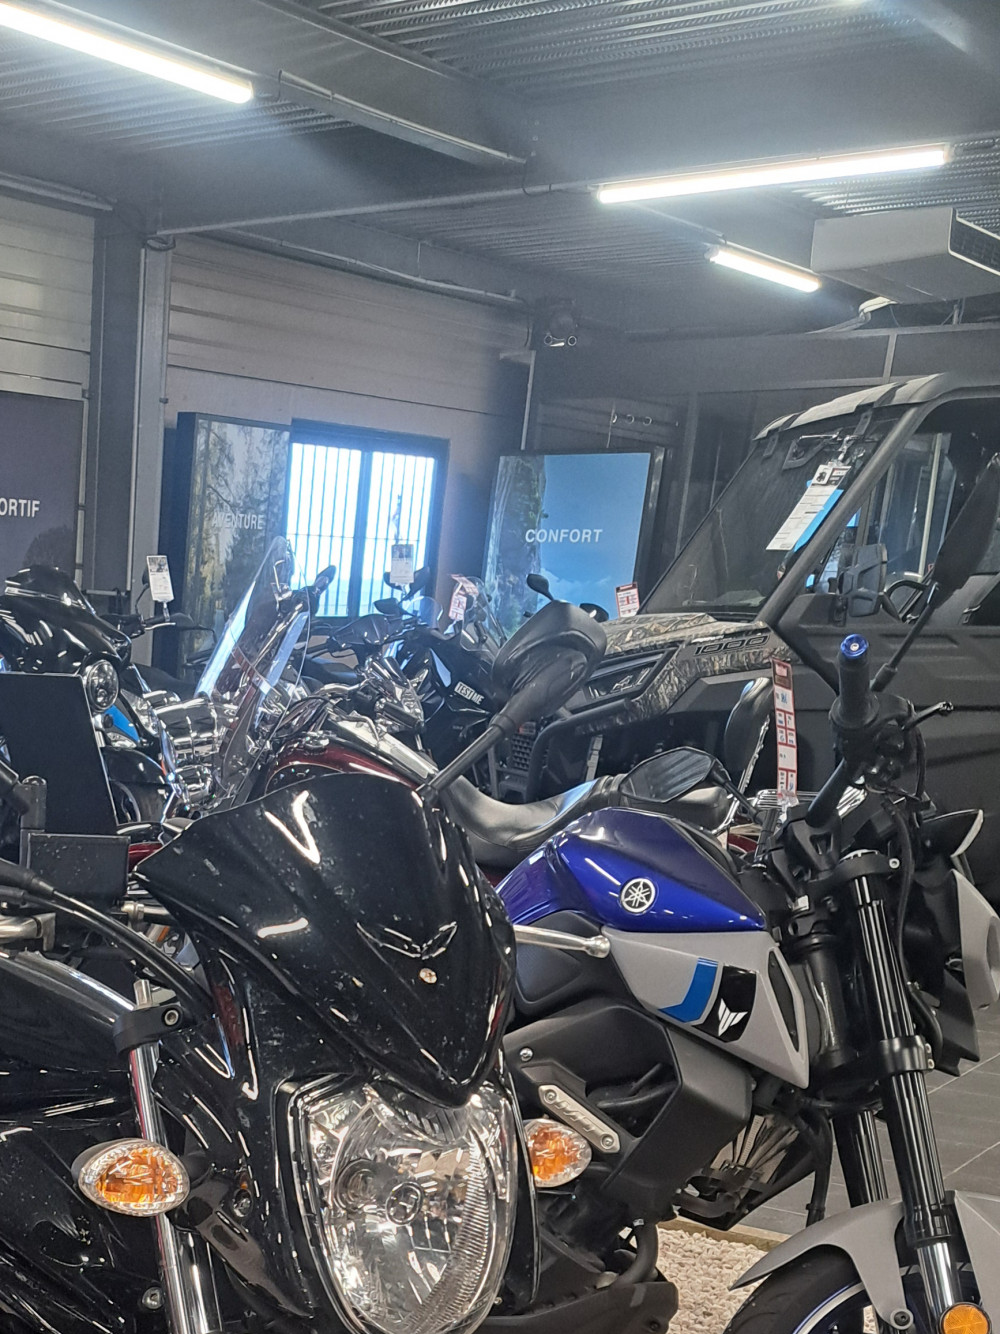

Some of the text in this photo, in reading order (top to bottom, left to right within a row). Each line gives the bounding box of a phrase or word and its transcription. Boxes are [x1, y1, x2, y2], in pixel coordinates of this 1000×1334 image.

[211, 511, 265, 530] AVENTURE
[525, 528, 603, 543] CONFORT
[694, 635, 770, 656] 1000
[455, 683, 485, 705] TEST ME
